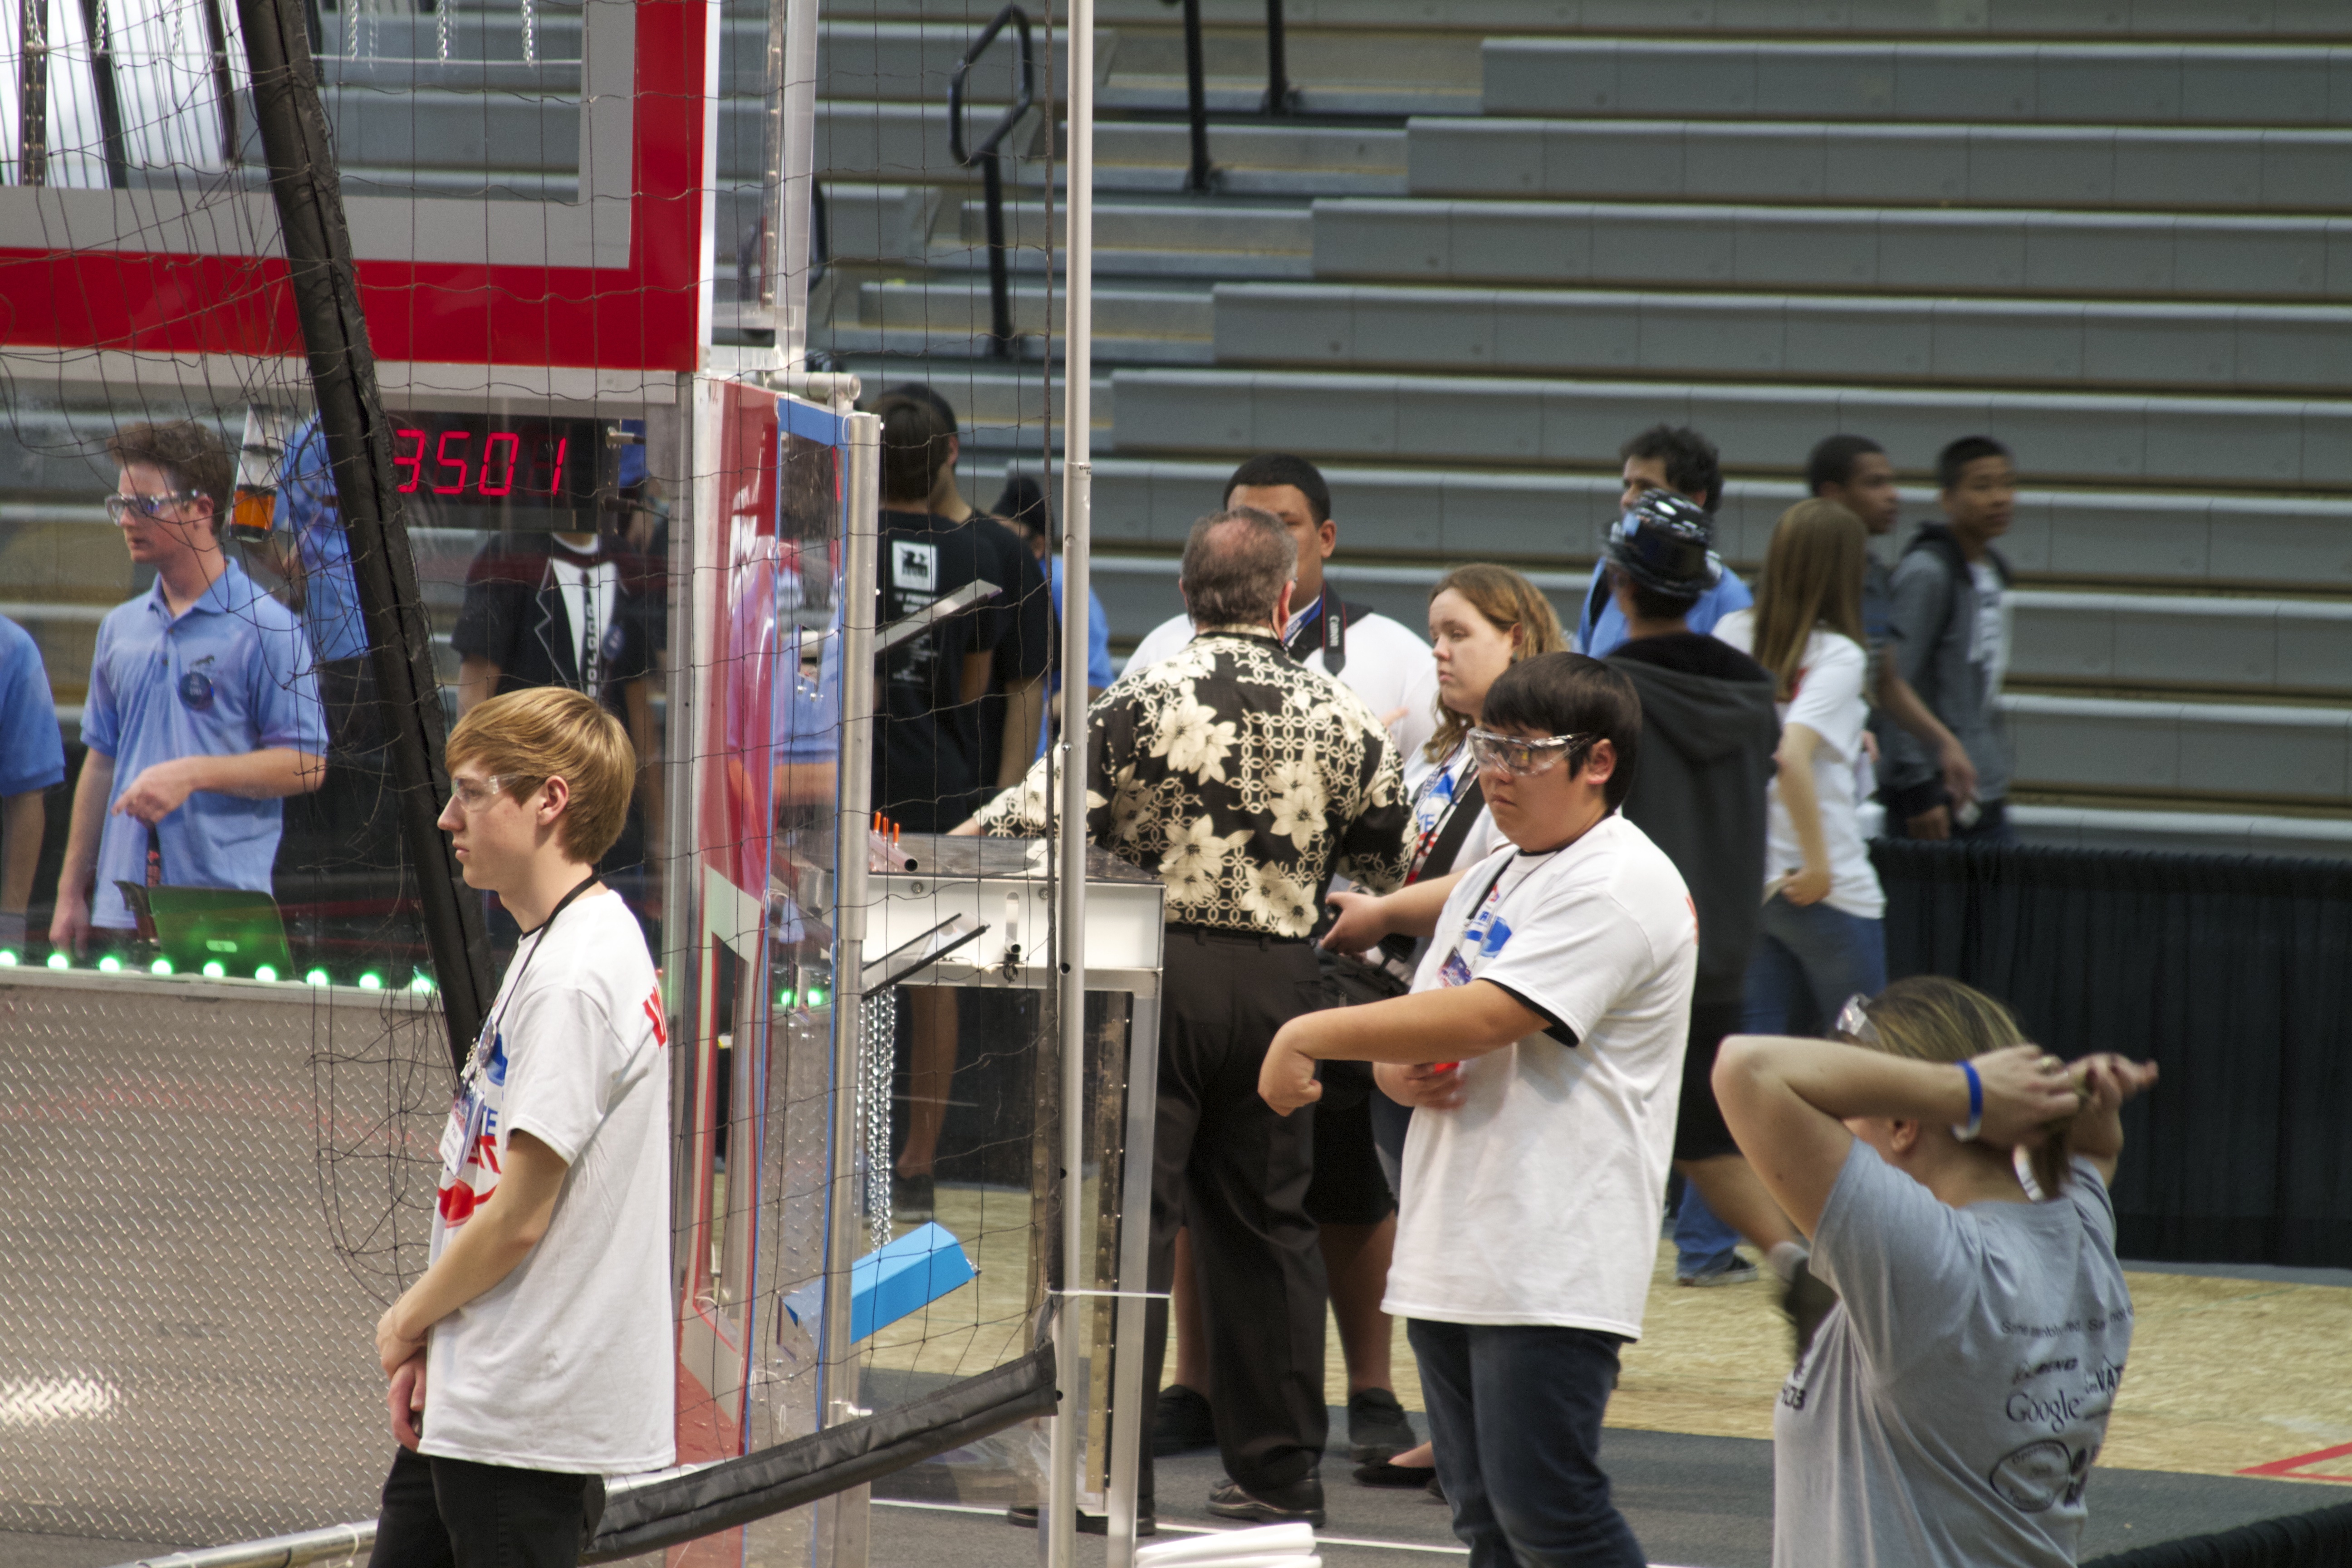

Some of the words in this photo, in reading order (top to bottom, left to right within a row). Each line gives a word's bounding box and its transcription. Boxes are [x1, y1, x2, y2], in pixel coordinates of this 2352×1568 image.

[393, 429, 567, 496] 3501
[1329, 615, 1340, 647] Canon
[2005, 1389, 2081, 1434] Google
